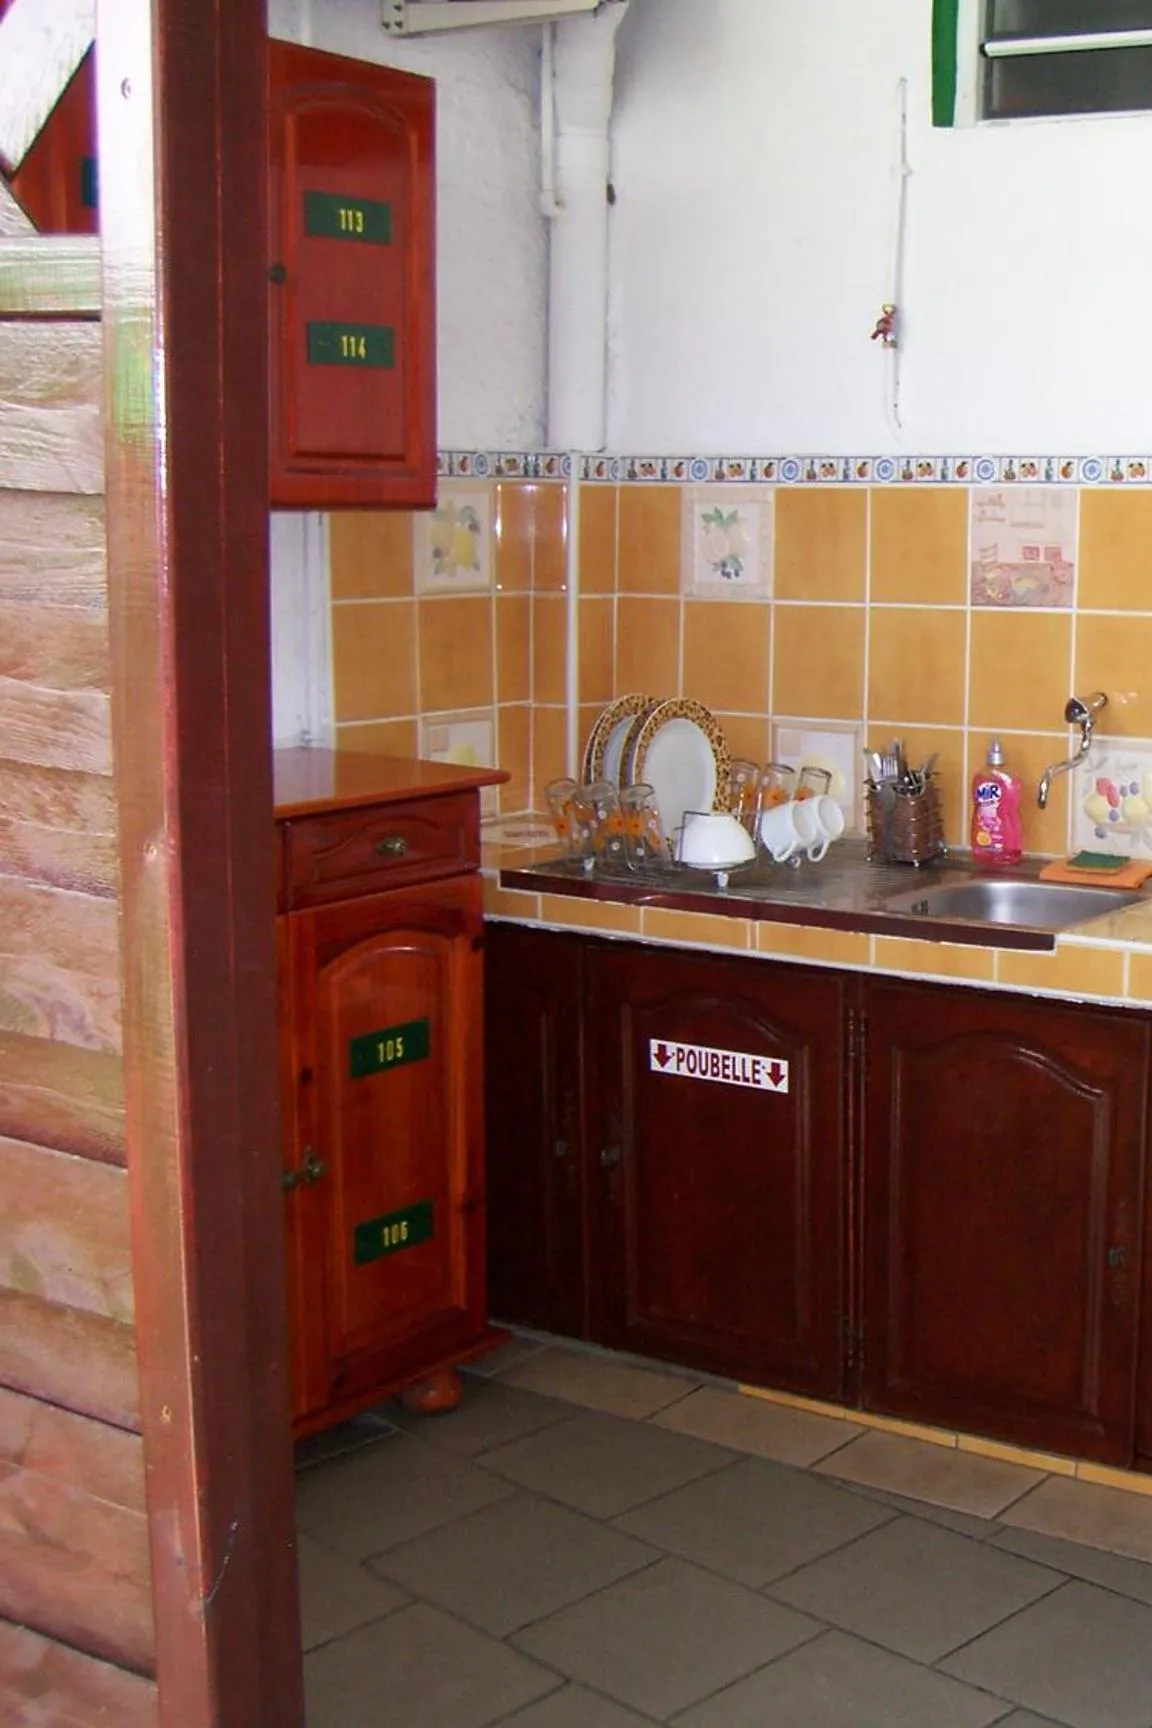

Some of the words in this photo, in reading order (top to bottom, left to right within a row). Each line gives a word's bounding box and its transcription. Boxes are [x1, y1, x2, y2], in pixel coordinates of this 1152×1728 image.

[338, 208, 364, 233] 113
[341, 335, 367, 359] 114
[377, 1037, 404, 1063] 105
[676, 1047, 762, 1085] POUBELLE
